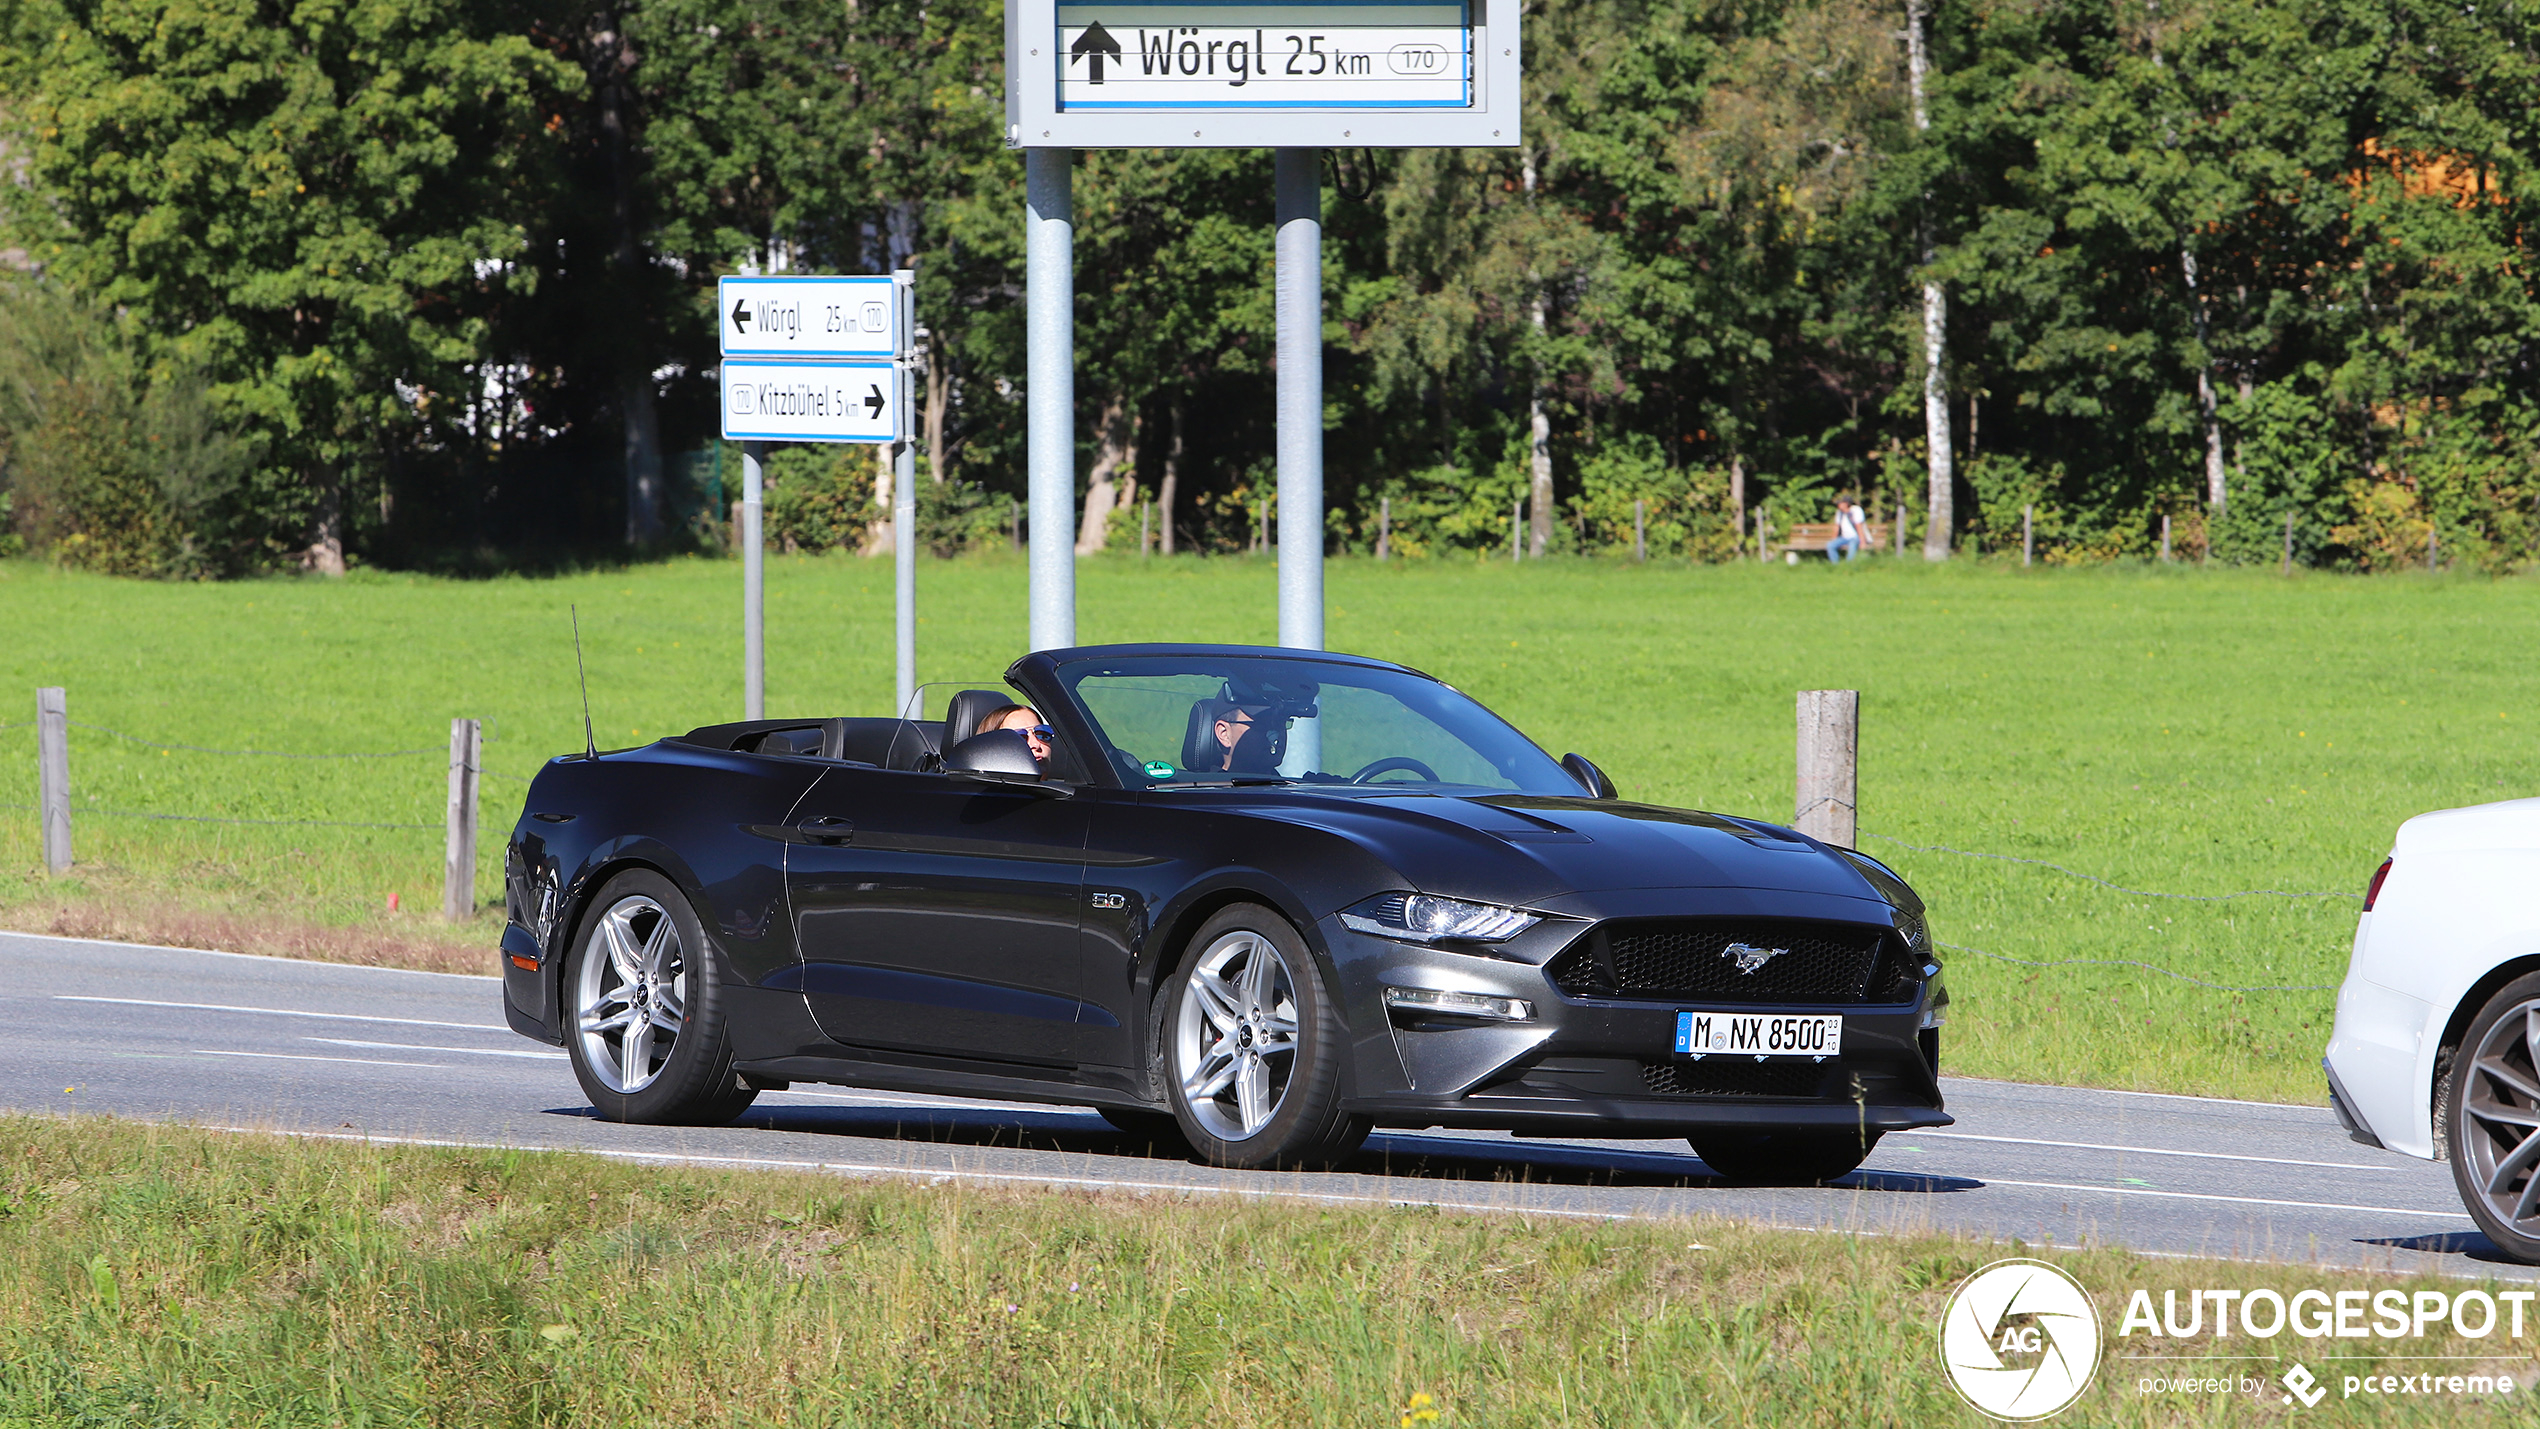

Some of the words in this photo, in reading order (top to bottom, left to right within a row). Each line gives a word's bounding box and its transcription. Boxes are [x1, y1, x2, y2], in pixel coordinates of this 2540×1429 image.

[1138, 27, 1267, 87] Wörgl
[1285, 35, 1327, 76] 25
[1335, 47, 1371, 75] km
[1402, 50, 1435, 69] 170
[757, 300, 802, 339] Wörgl
[826, 305, 841, 333] 25
[844, 317, 857, 333] km
[867, 308, 881, 326] 170
[736, 390, 750, 408] 170
[759, 382, 830, 416] Kitzbühel
[836, 390, 843, 416] 5
[845, 399, 859, 417] km
[1678, 1036, 1685, 1046] D
[1694, 1016, 1711, 1048] M
[1730, 1018, 1763, 1049] NX
[1768, 1019, 1825, 1050] 8500
[1828, 1019, 1838, 1029] 03
[1827, 1042, 1837, 1051] 10
